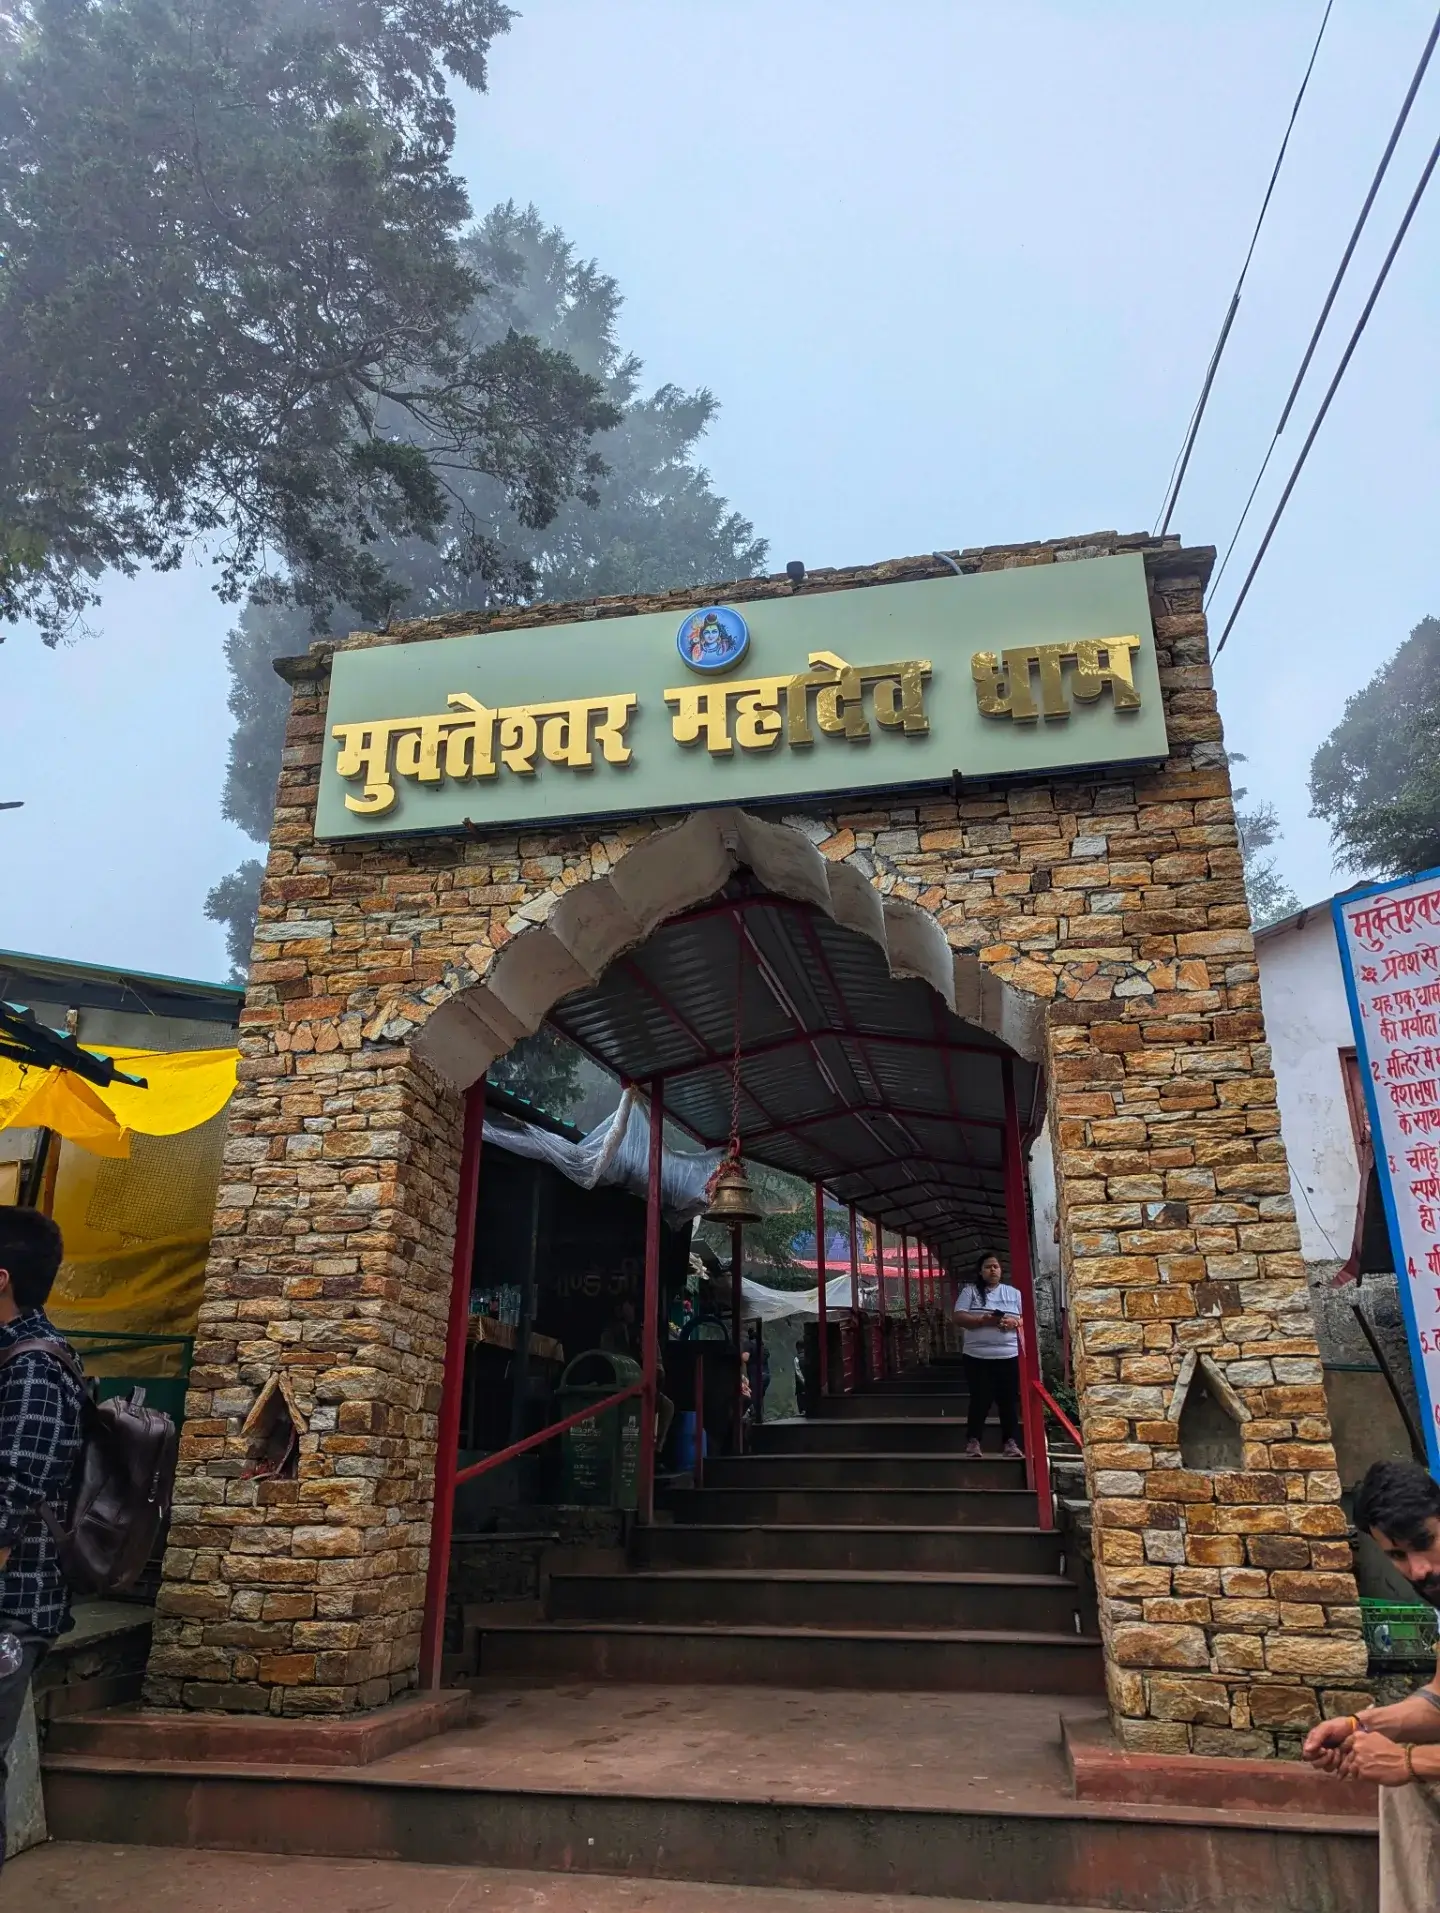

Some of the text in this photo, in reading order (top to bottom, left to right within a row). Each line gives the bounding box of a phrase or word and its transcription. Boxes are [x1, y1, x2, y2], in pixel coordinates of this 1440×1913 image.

[332, 634, 1140, 816] मुक्तेश्वर महादेव धाम
[1380, 949, 1421, 982] प्रवेश
[1371, 994, 1396, 1018] यह
[1391, 990, 1416, 1014] एक
[1379, 1009, 1439, 1044] की मर्यादा
[1385, 1048, 1426, 1079] मन्दिर
[1413, 1045, 1436, 1073] में
[1383, 1079, 1439, 1109] वेशभूषा
[1393, 1109, 1413, 1136] के
